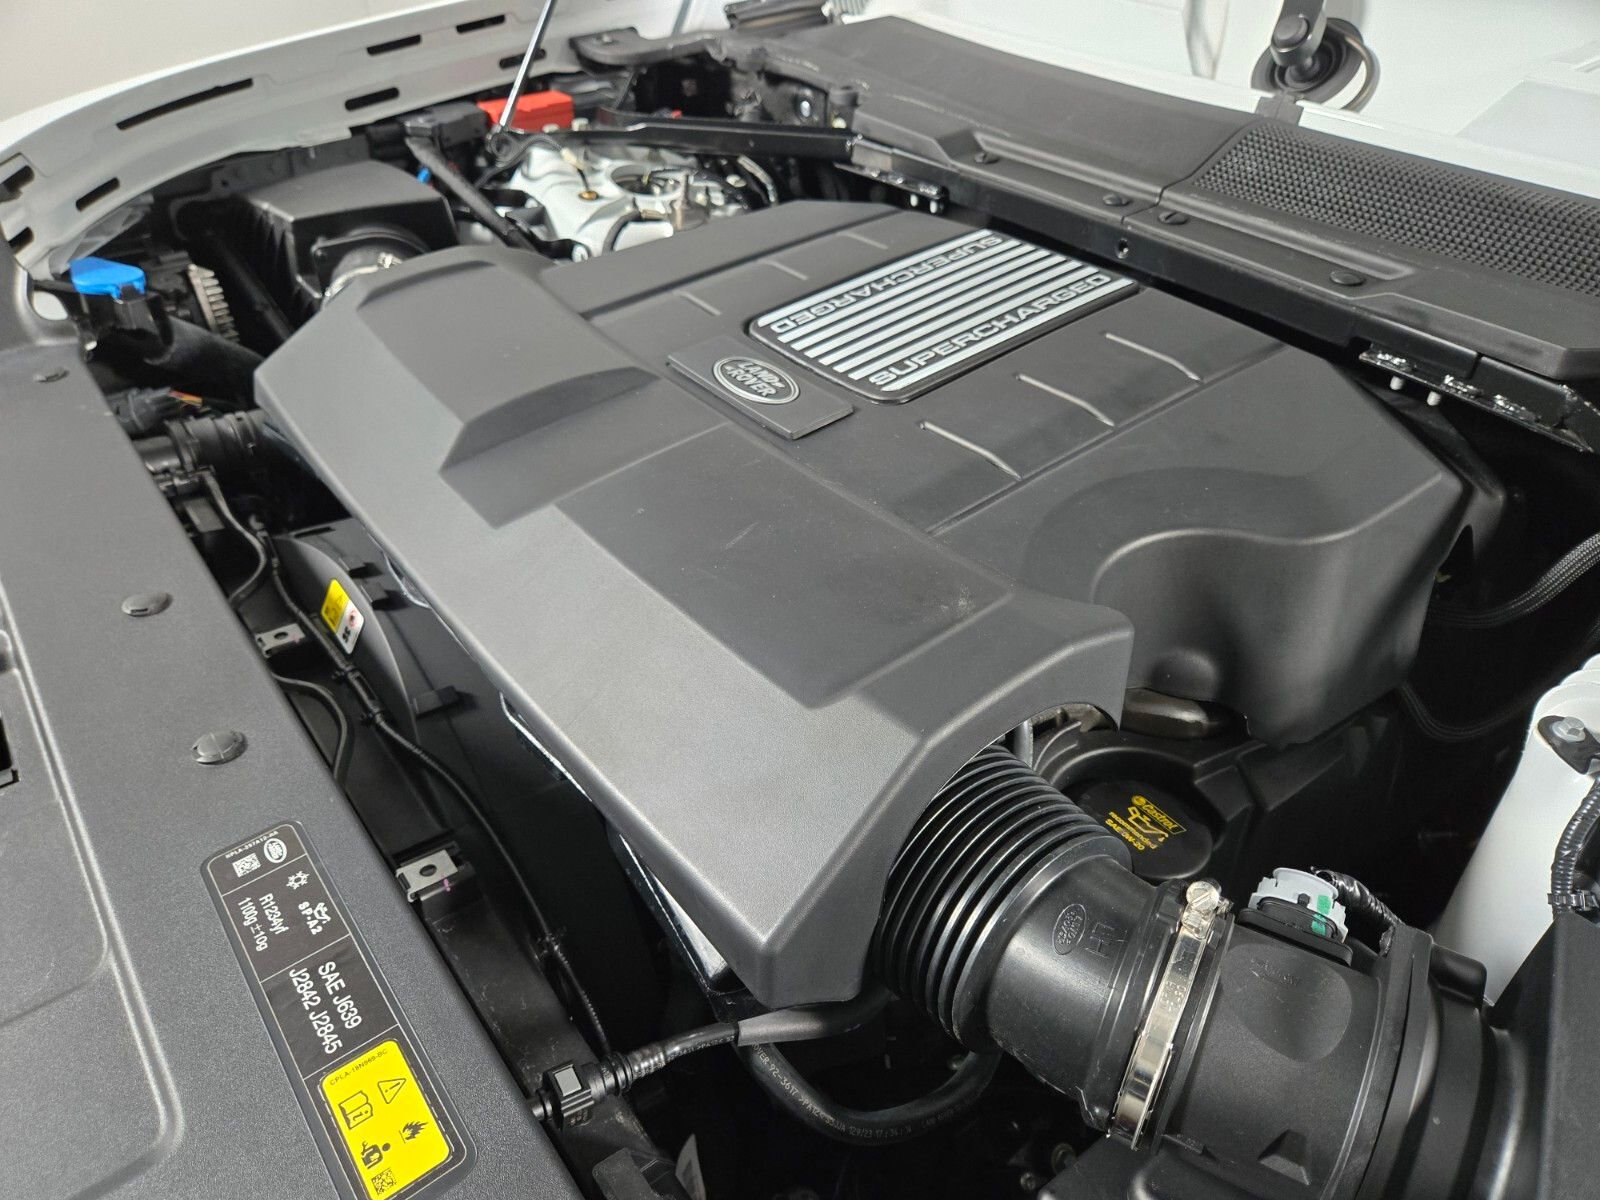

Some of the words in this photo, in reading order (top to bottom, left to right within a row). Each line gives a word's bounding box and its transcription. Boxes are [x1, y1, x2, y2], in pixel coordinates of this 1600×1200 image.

[770, 236, 1003, 334] SUPERCHARGED
[868, 274, 1112, 385] SUPERCHARGED
[727, 368, 777, 396] ROVER
[738, 362, 782, 384] LAND
[1105, 819, 1122, 834] SAE
[1109, 811, 1158, 849] recommended
[1142, 804, 1178, 830] Castrol
[238, 897, 258, 926] 1100g
[259, 893, 290, 934] R1234yf
[289, 968, 321, 1010] J2842
[309, 1010, 343, 1054] J2845
[318, 961, 346, 995] SAE
[333, 994, 362, 1029] J639
[752, 1042, 769, 1064] OVER
[770, 1063, 799, 1096] 92-3617
